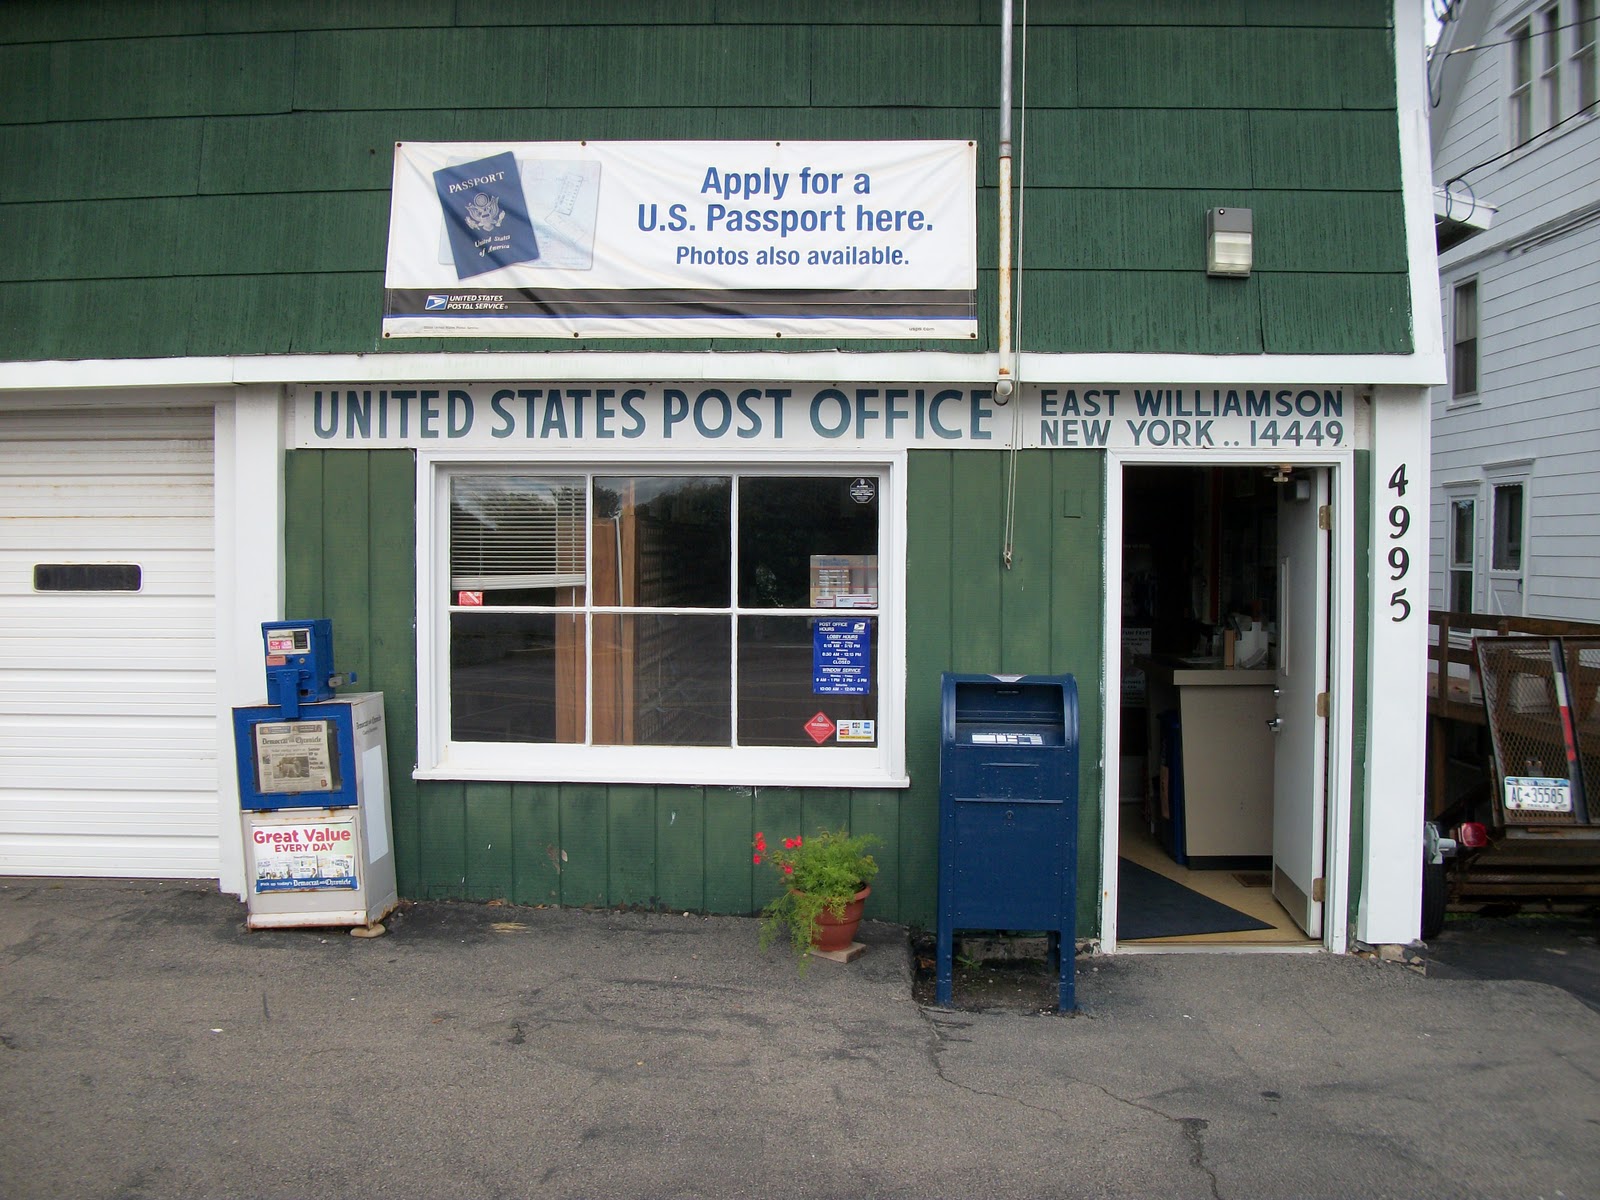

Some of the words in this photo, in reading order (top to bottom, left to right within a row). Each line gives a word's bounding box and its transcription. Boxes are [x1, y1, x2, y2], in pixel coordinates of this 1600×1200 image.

[449, 171, 505, 194] PASSPORT
[700, 166, 789, 200] Apply
[799, 166, 843, 194] for
[853, 173, 871, 194] a
[637, 203, 696, 232] U.S.
[706, 204, 845, 237] Passport
[856, 205, 934, 232] here.
[474, 235, 492, 248] United
[493, 233, 511, 243] States
[479, 247, 486, 257] of
[488, 243, 510, 254] America
[676, 246, 749, 265] Photos
[756, 246, 800, 265] also
[807, 246, 909, 265] available.
[447, 302, 473, 310] POSTAL
[448, 294, 475, 302] UNITED
[476, 294, 503, 302] STATES
[1040, 389, 1120, 417] EAST
[1134, 389, 1343, 417] WILLIAMSON
[313, 390, 475, 439] UNITED
[491, 389, 646, 439] STATES
[663, 388, 792, 439] POST
[809, 388, 993, 439] OFFICE
[1040, 419, 1111, 446] NEW
[1250, 420, 1343, 447] 14449
[1388, 463, 1411, 622] 4995
[1511, 787, 1523, 803] AC
[1531, 787, 1564, 804] 35585
[253, 829, 299, 844] Great
[303, 827, 351, 842] Value
[274, 843, 309, 853] EVERY
[312, 842, 335, 852] DAY
